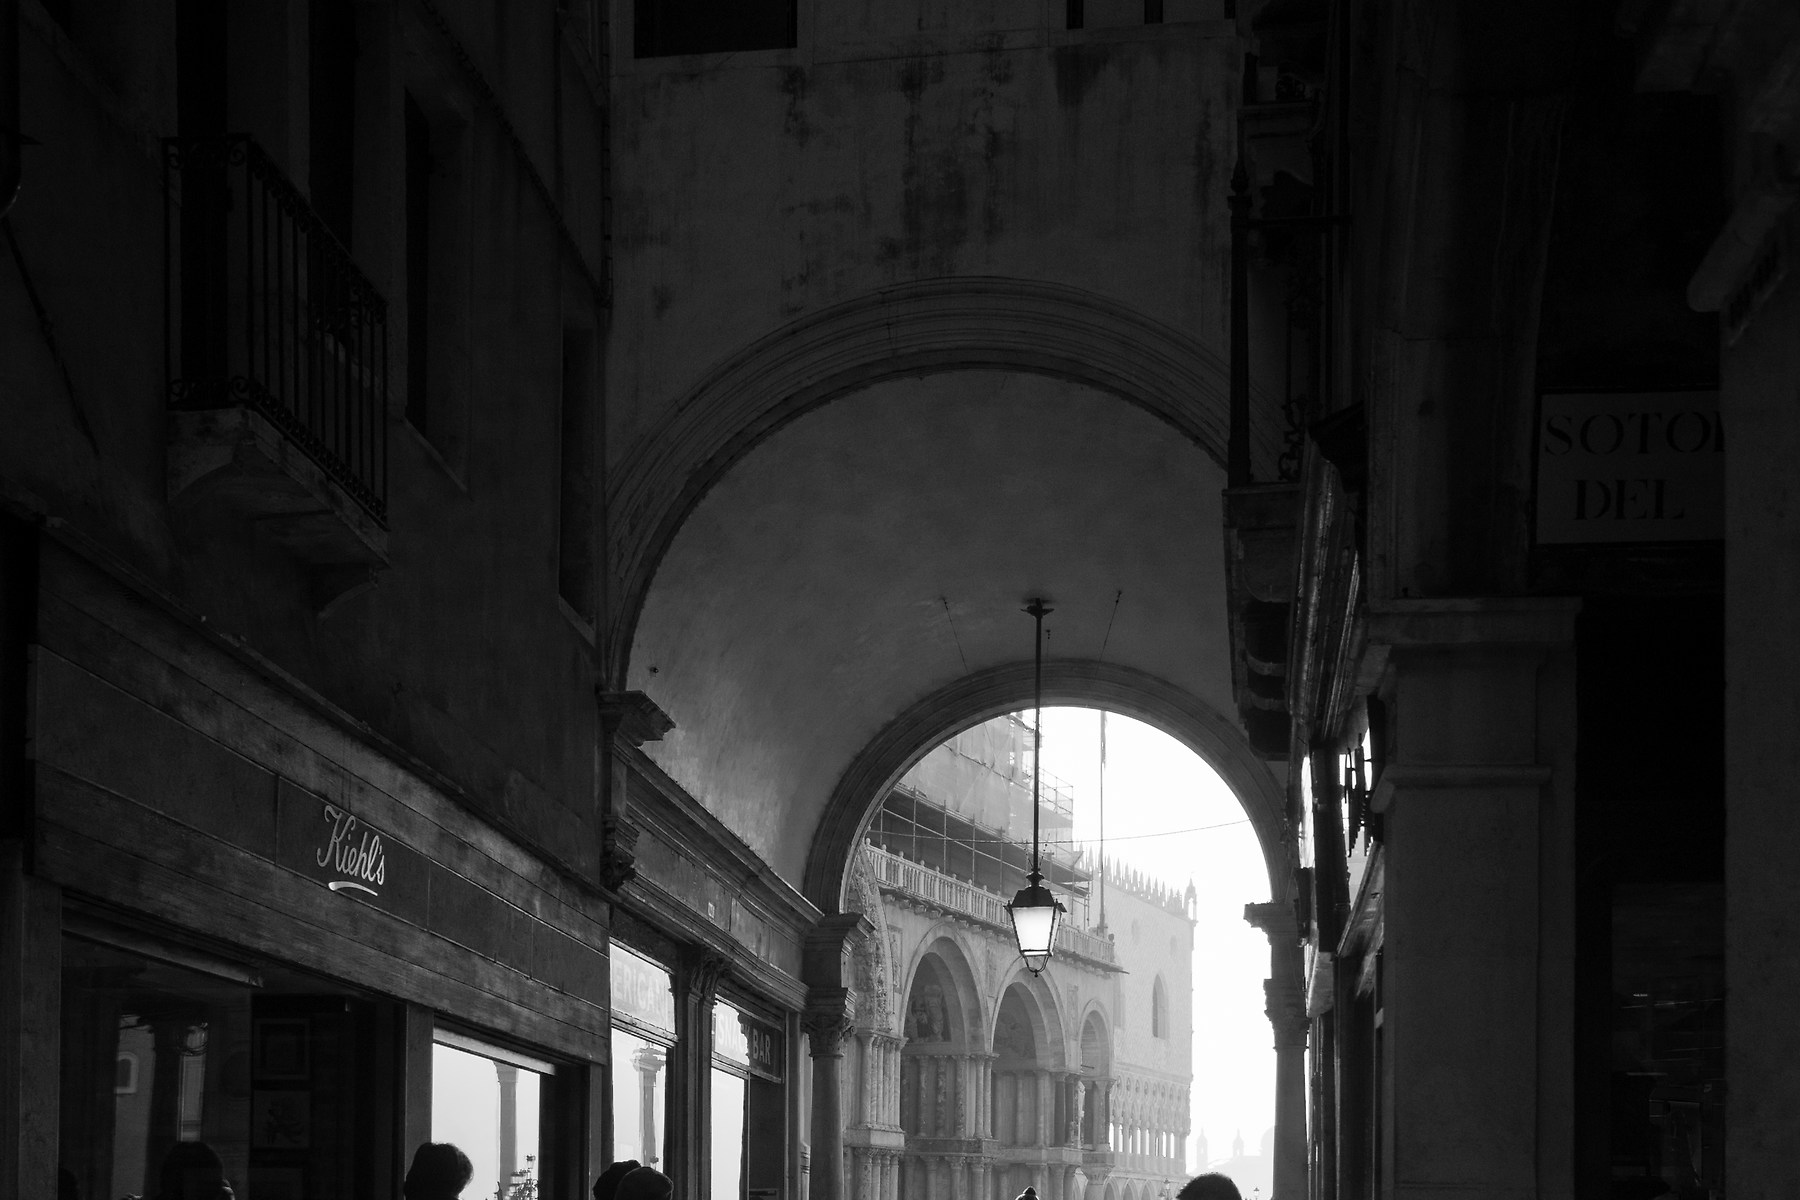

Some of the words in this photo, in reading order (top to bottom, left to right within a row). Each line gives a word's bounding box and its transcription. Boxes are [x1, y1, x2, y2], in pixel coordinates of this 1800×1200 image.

[1574, 479, 1685, 521] DEL
[316, 805, 385, 886] Kiehl's
[752, 1027, 771, 1066] BAR
